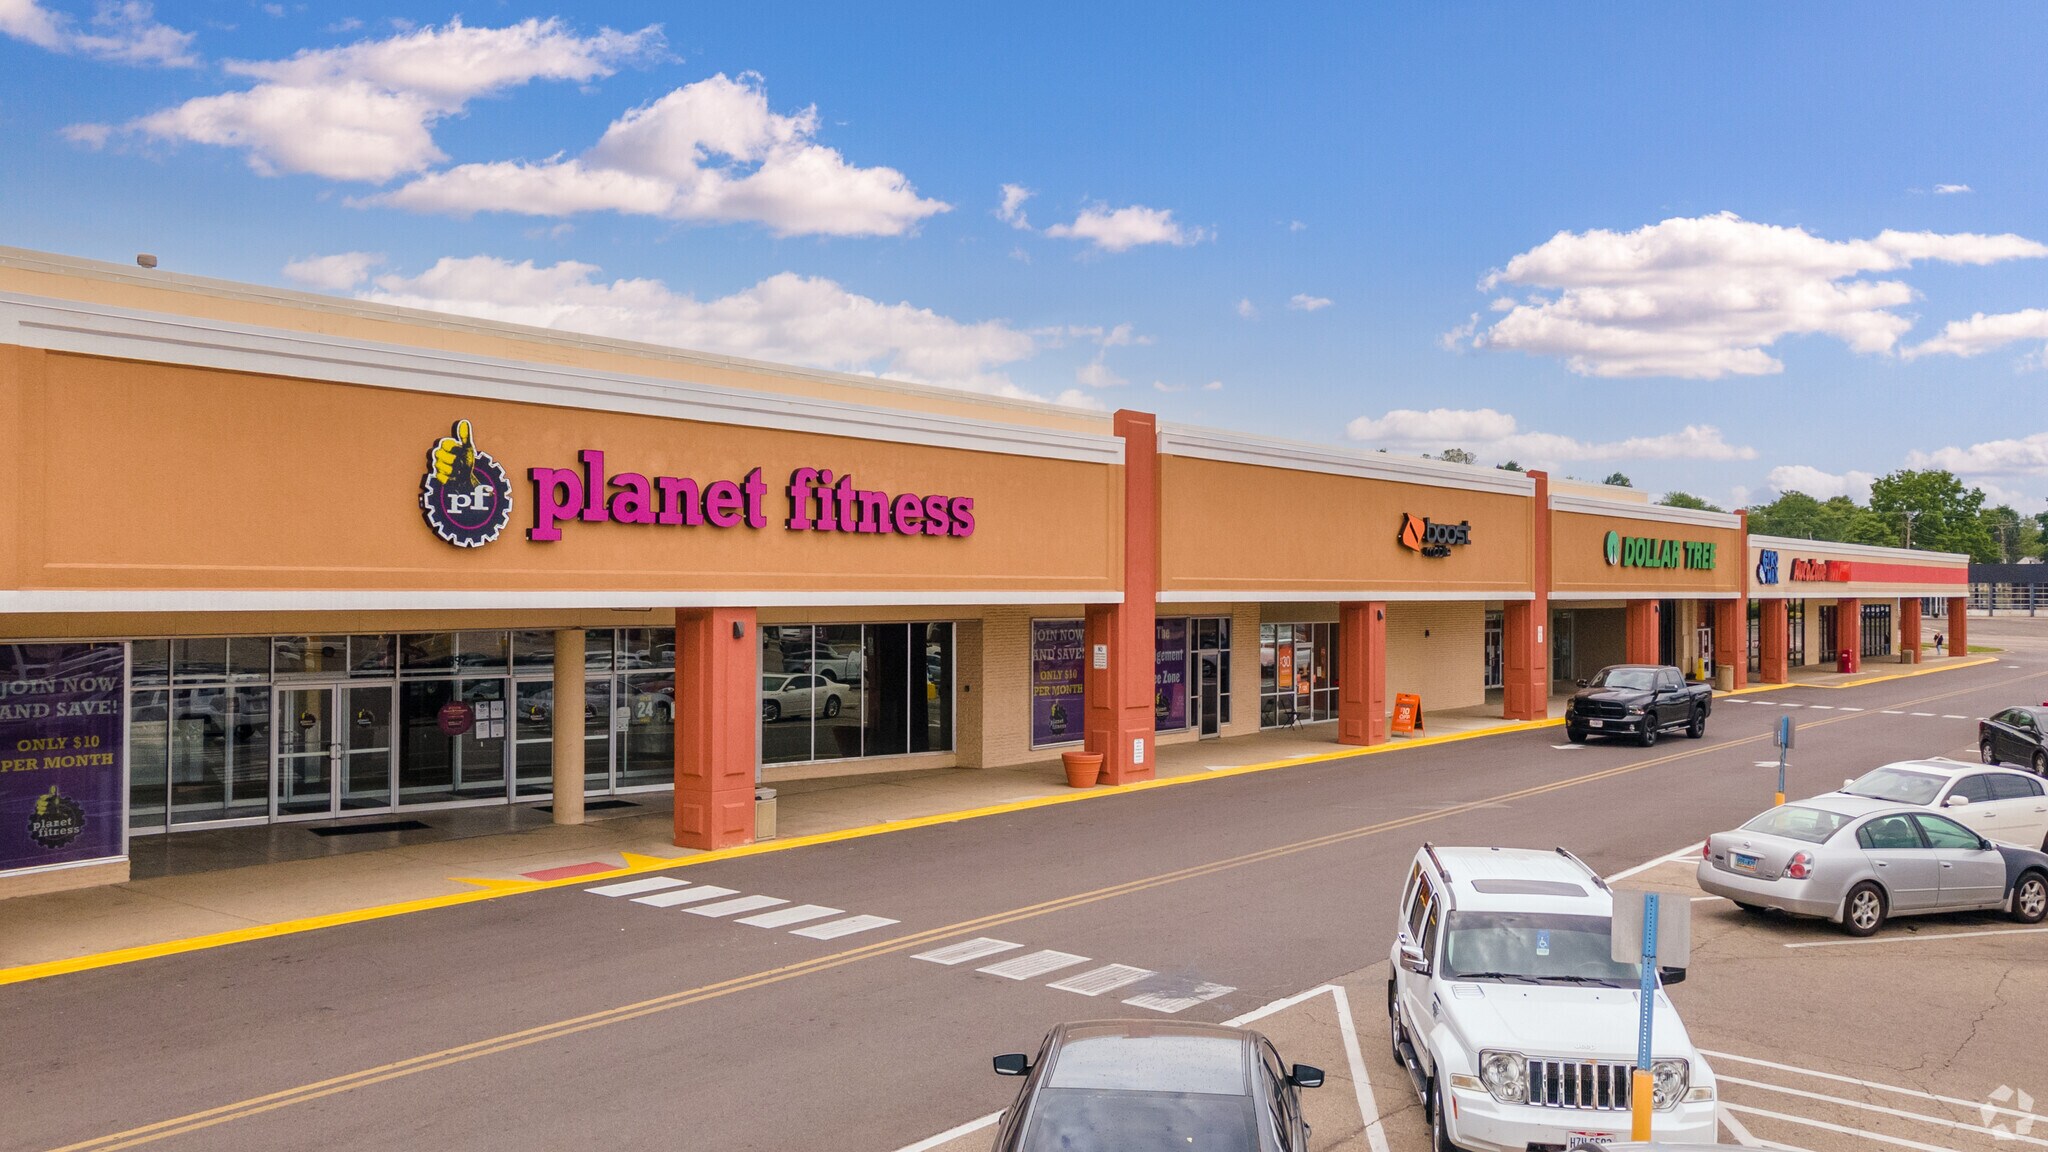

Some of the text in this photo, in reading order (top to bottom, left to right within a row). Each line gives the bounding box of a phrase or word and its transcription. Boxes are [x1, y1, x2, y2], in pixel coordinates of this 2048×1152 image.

[447, 484, 494, 514] pf
[527, 449, 975, 541] planet fitness
[1423, 517, 1472, 545] boost
[1622, 536, 1717, 569] DOLLAR TREE
[1033, 628, 1085, 645] JOIN NOW
[1156, 626, 1170, 640] The
[1033, 648, 1055, 661] AND
[1040, 669, 1078, 680] ONLY $10
[1163, 670, 1180, 684] Zone
[0, 676, 118, 699] JOIN NOW
[1034, 684, 1083, 697] PER MONTH
[0, 700, 118, 719] AND SAVE!
[637, 701, 654, 718] 24
[17, 735, 100, 752] ONLY $10
[0, 753, 114, 773] PER MONTH
[33, 817, 72, 831] planet
[38, 826, 80, 838] fitness
